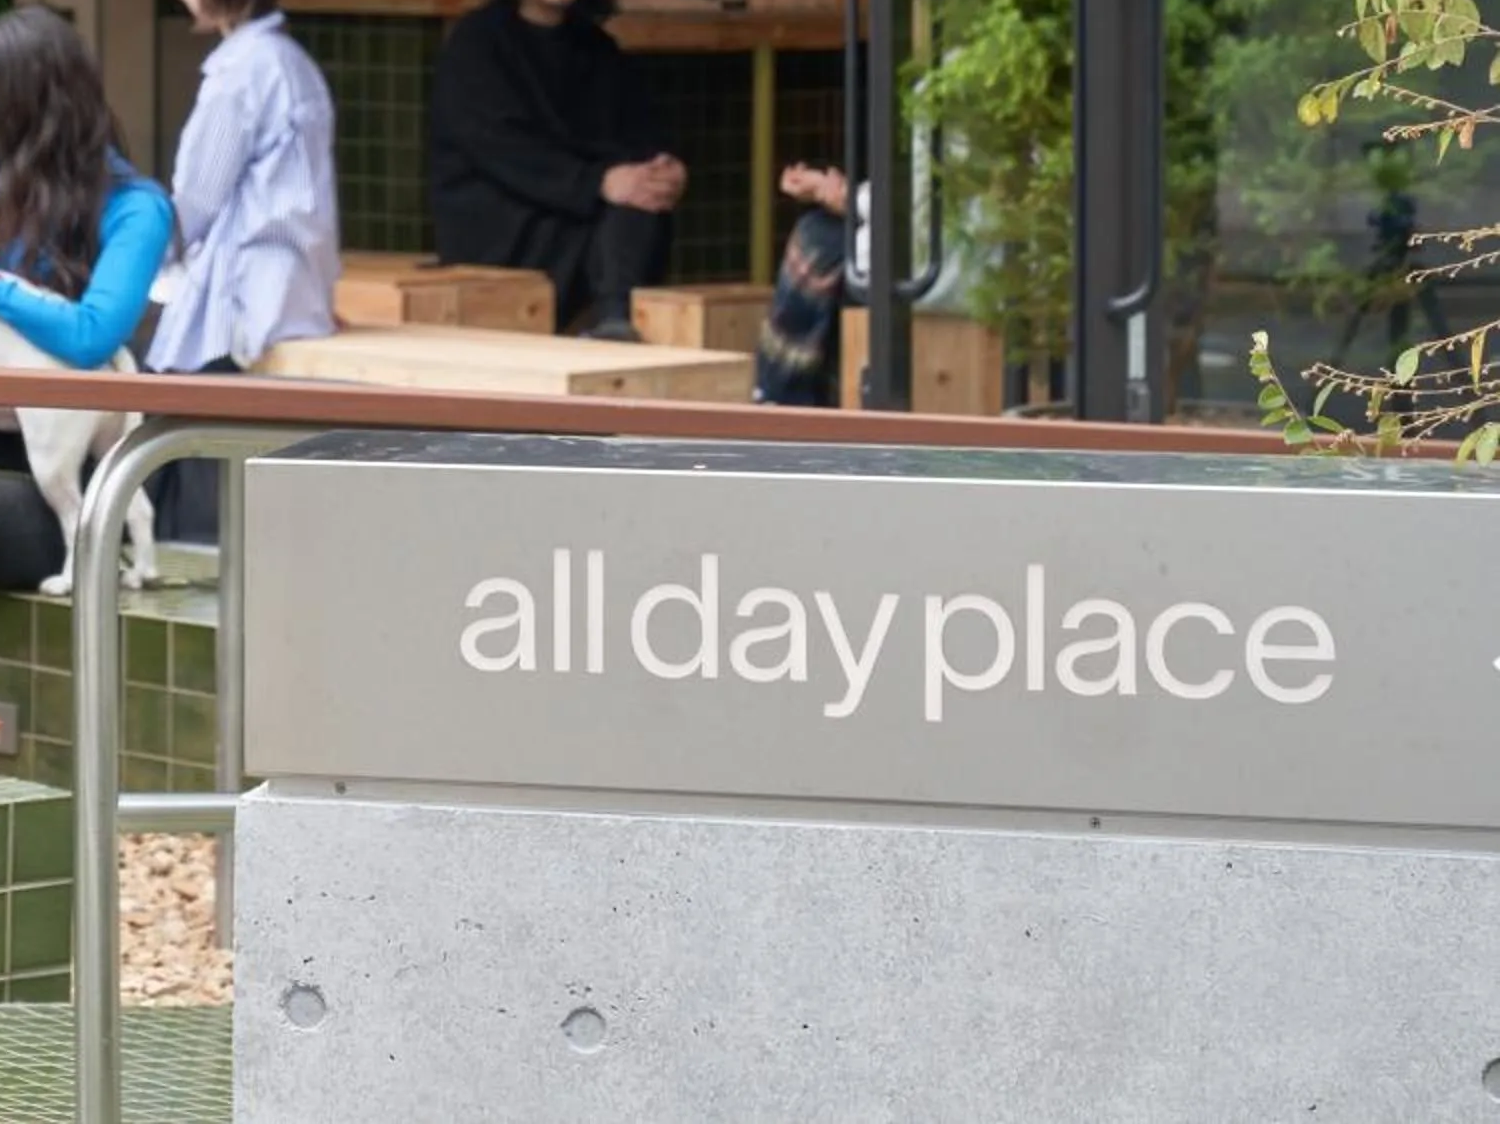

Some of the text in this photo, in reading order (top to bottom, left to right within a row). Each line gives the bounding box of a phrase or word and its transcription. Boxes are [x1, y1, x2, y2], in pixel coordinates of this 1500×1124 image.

[459, 549, 1337, 723] all day place
